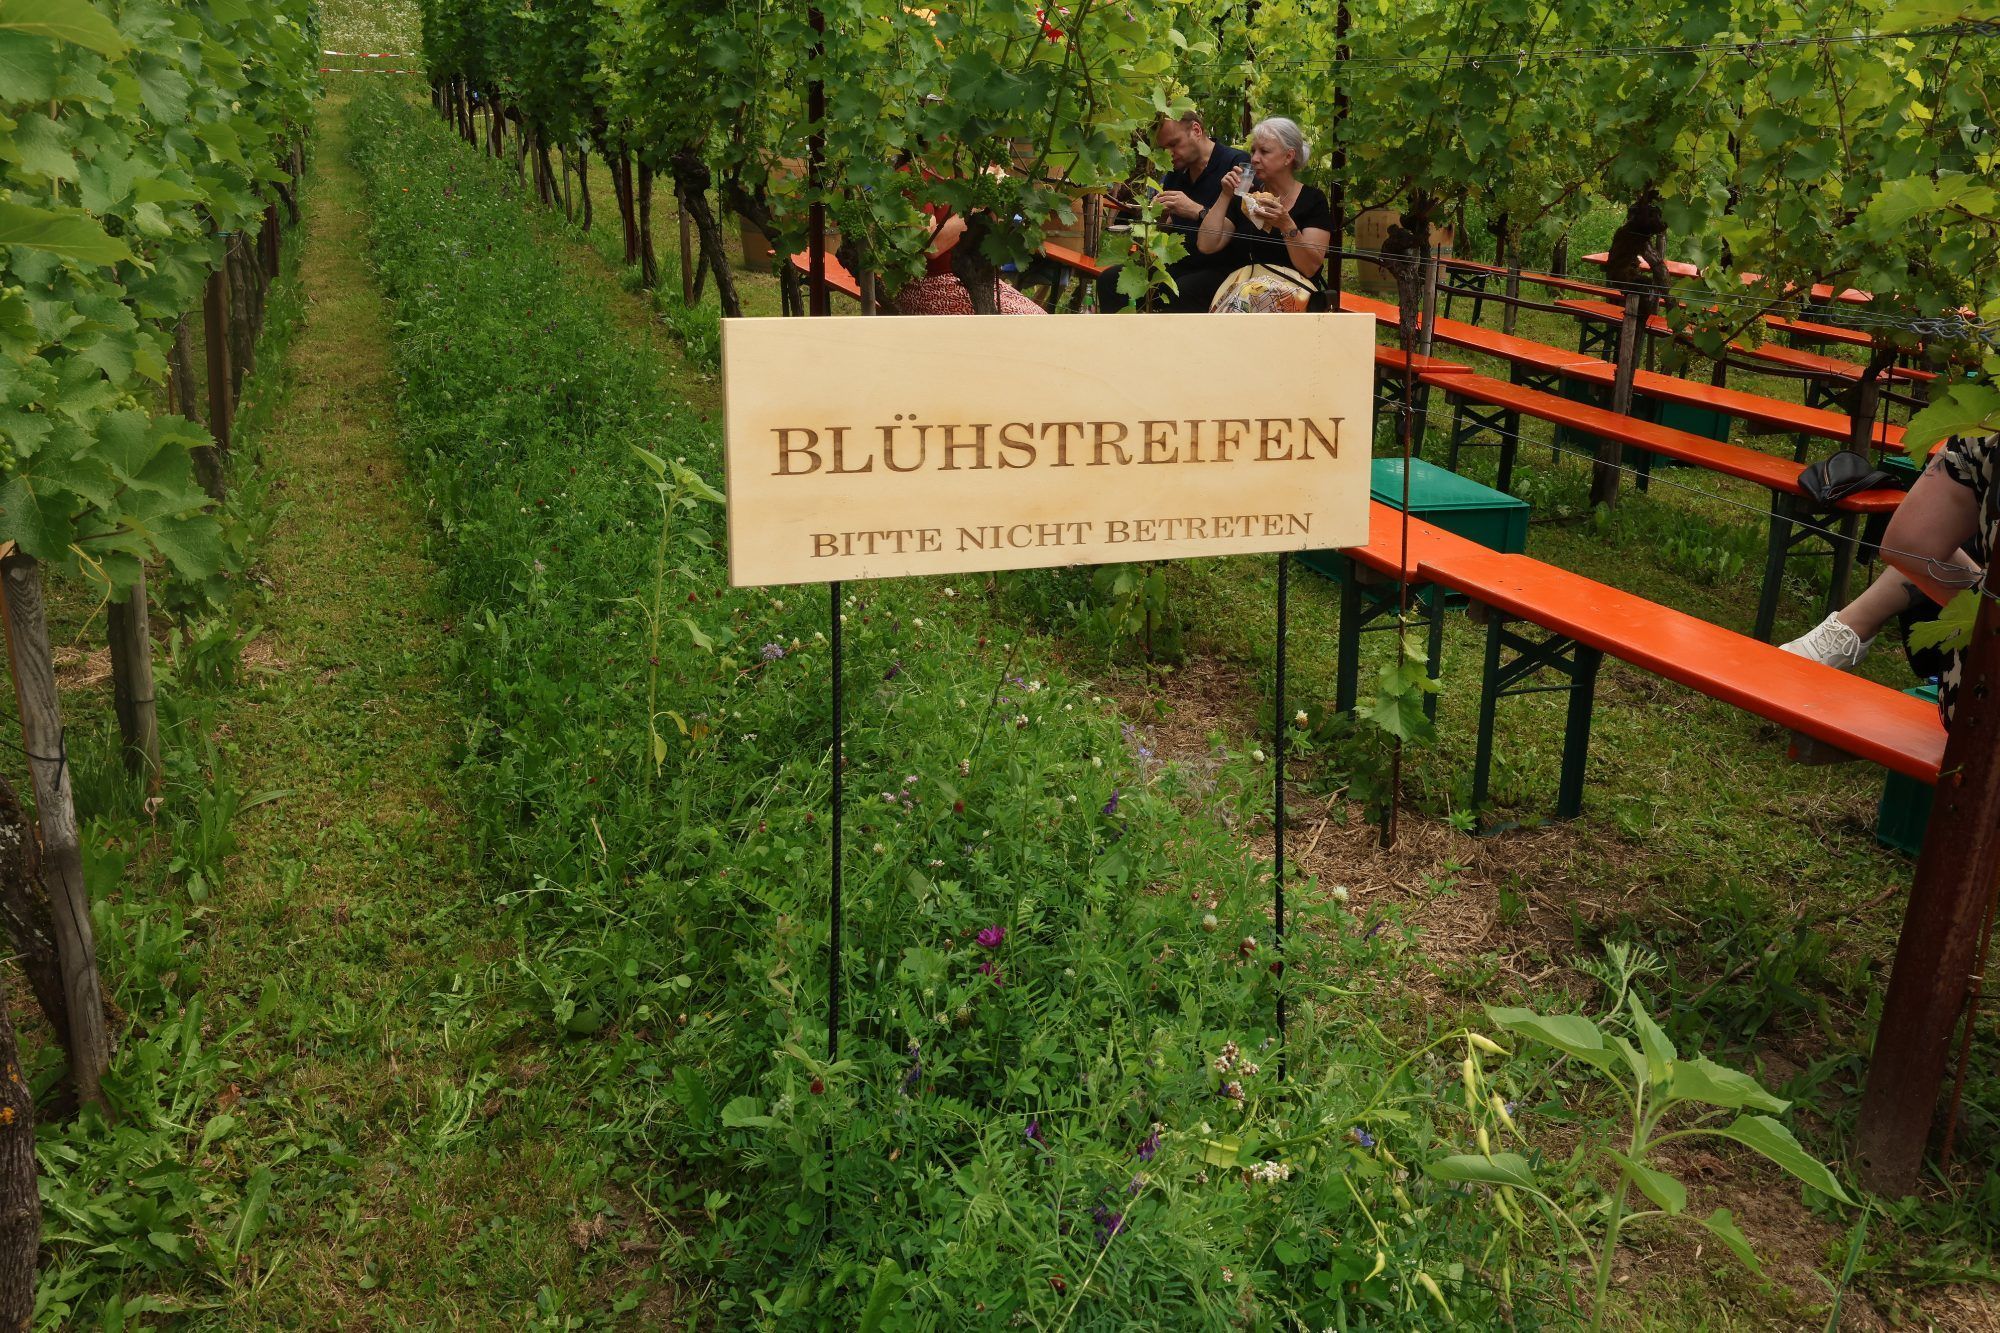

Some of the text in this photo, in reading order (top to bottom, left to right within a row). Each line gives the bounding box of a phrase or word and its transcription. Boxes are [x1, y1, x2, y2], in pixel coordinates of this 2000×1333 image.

[771, 414, 1345, 476] BLÜHSTREIFEN
[810, 513, 1312, 558] BITTE NICHT BETRETEN
